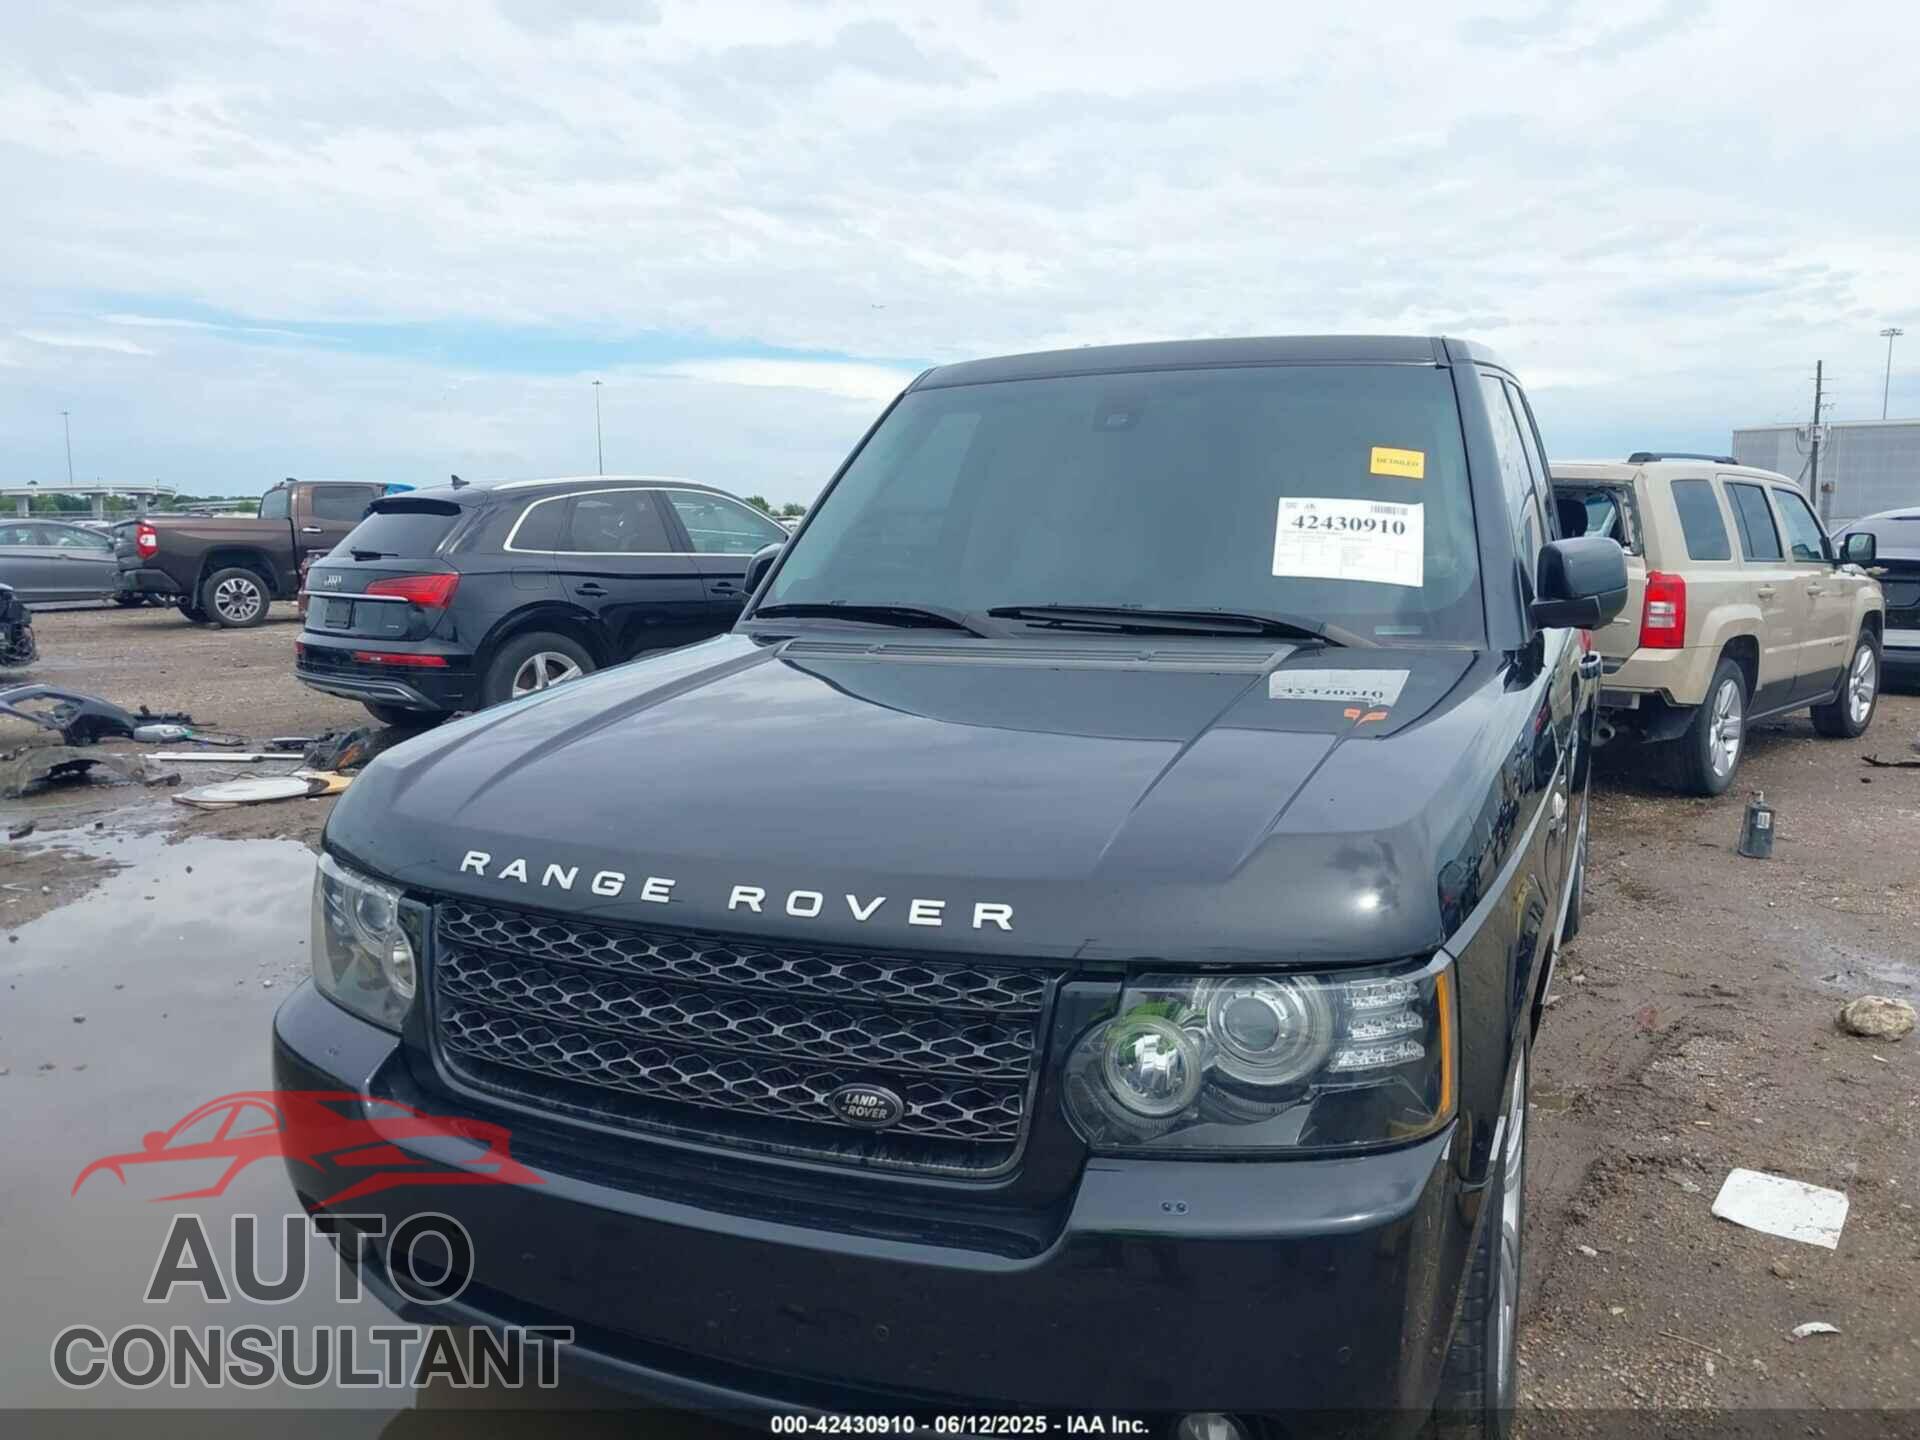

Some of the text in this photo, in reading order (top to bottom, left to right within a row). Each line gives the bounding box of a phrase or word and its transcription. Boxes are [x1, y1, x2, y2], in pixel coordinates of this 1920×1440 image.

[1291, 514, 1406, 536] 42430910
[460, 850, 1014, 931] RANGE ROVER
